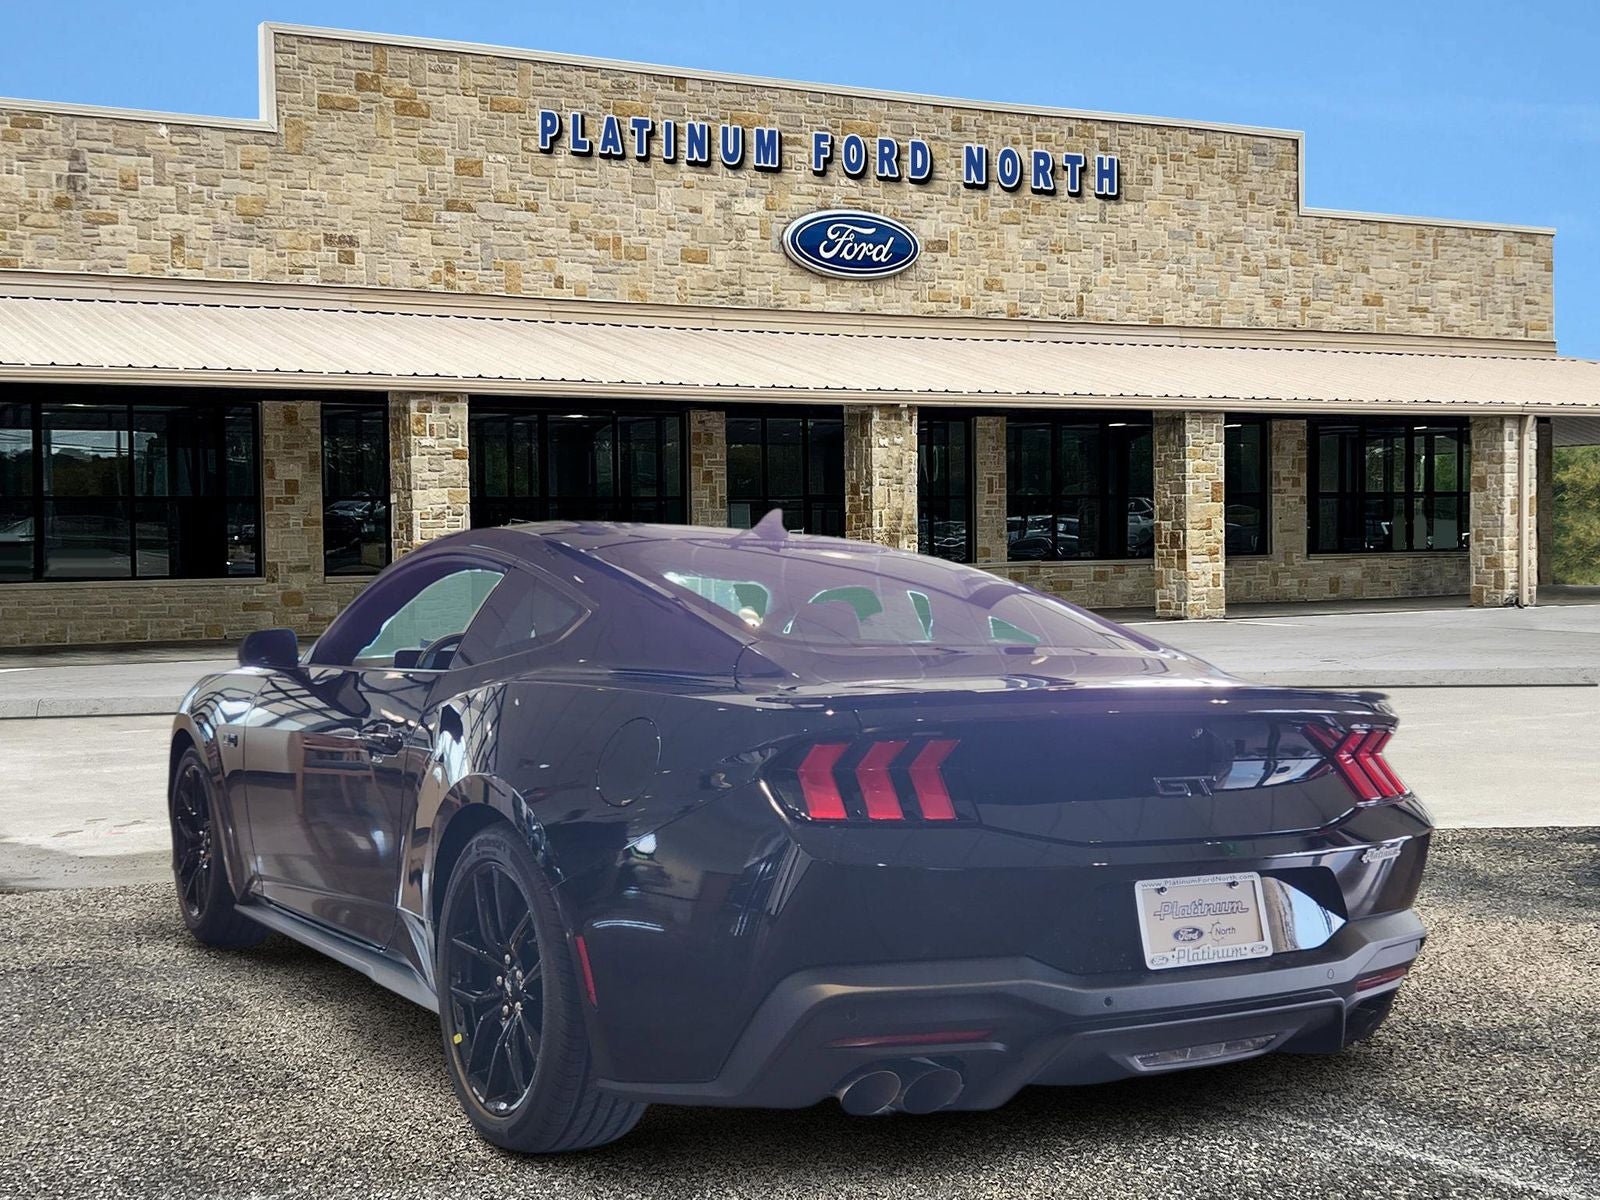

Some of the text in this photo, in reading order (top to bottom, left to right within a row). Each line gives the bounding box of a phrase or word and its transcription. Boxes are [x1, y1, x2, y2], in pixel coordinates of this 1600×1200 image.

[539, 109, 1120, 198] PLATINUM FORD NORTH
[819, 222, 896, 263] Ford
[1153, 775, 1217, 797] GT
[1141, 873, 1255, 888] www.PlatinumFordNorth.com
[1153, 898, 1249, 920] Platinum
[1177, 927, 1200, 941] Ford
[1215, 925, 1236, 935] North
[1175, 945, 1248, 964] Platinum
